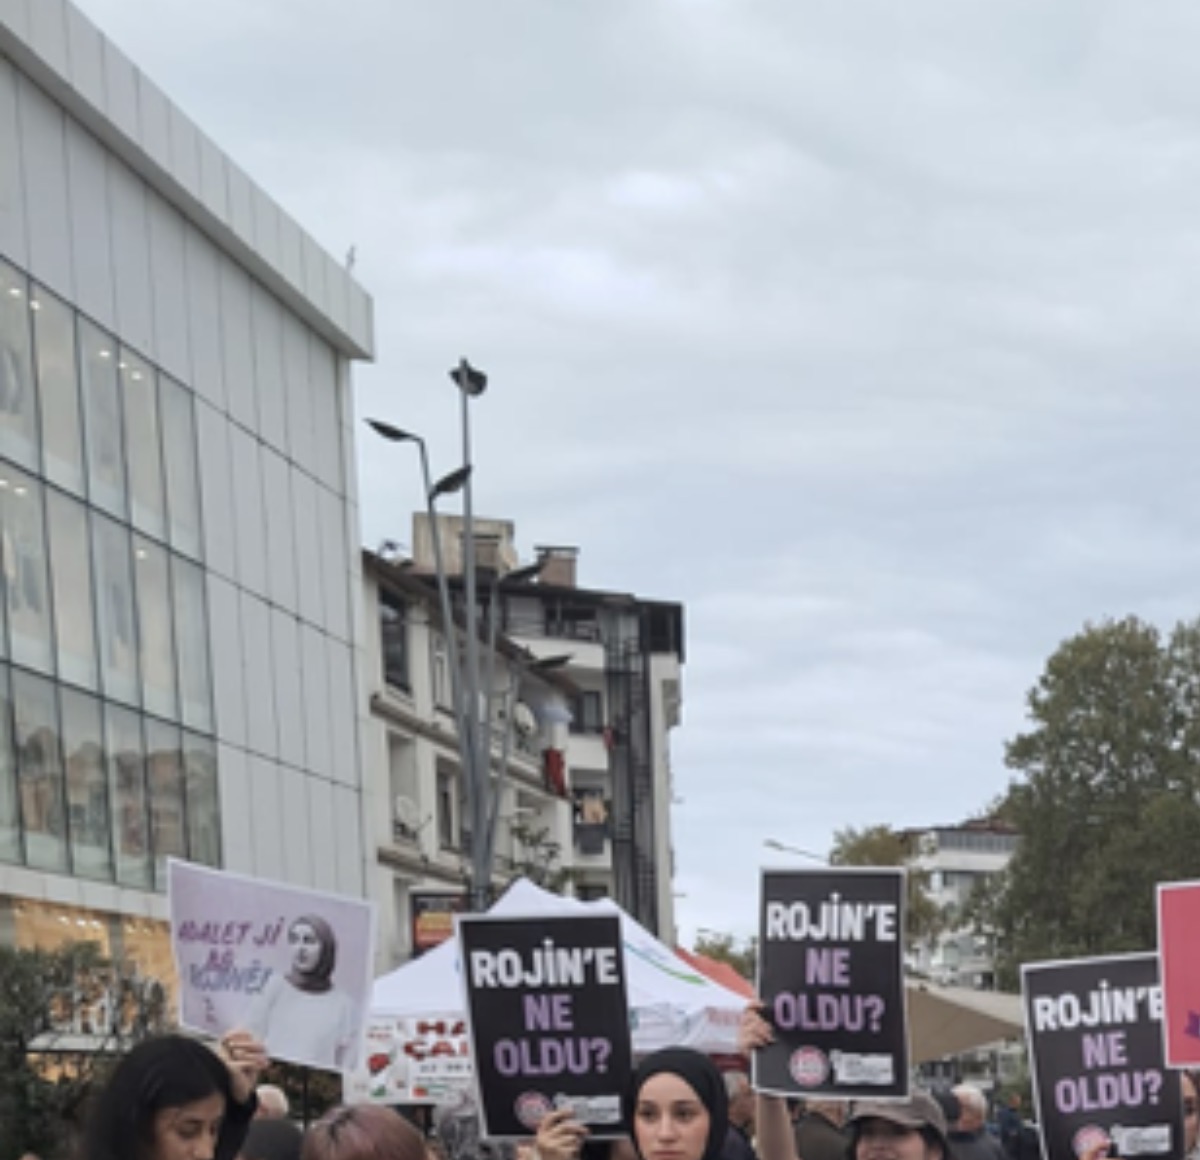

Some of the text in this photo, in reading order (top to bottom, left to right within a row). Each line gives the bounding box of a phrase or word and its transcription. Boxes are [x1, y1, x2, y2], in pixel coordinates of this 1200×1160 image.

[766, 891, 898, 942] ROJİN'E
[470, 936, 620, 988] ROJİN'E
[805, 949, 851, 986] NE
[523, 994, 574, 1031] NE
[774, 992, 885, 1032] OLDU?
[494, 1038, 611, 1075] OLDU?
[1081, 1031, 1128, 1070] NE
[1054, 1070, 1162, 1113] OLDU?
